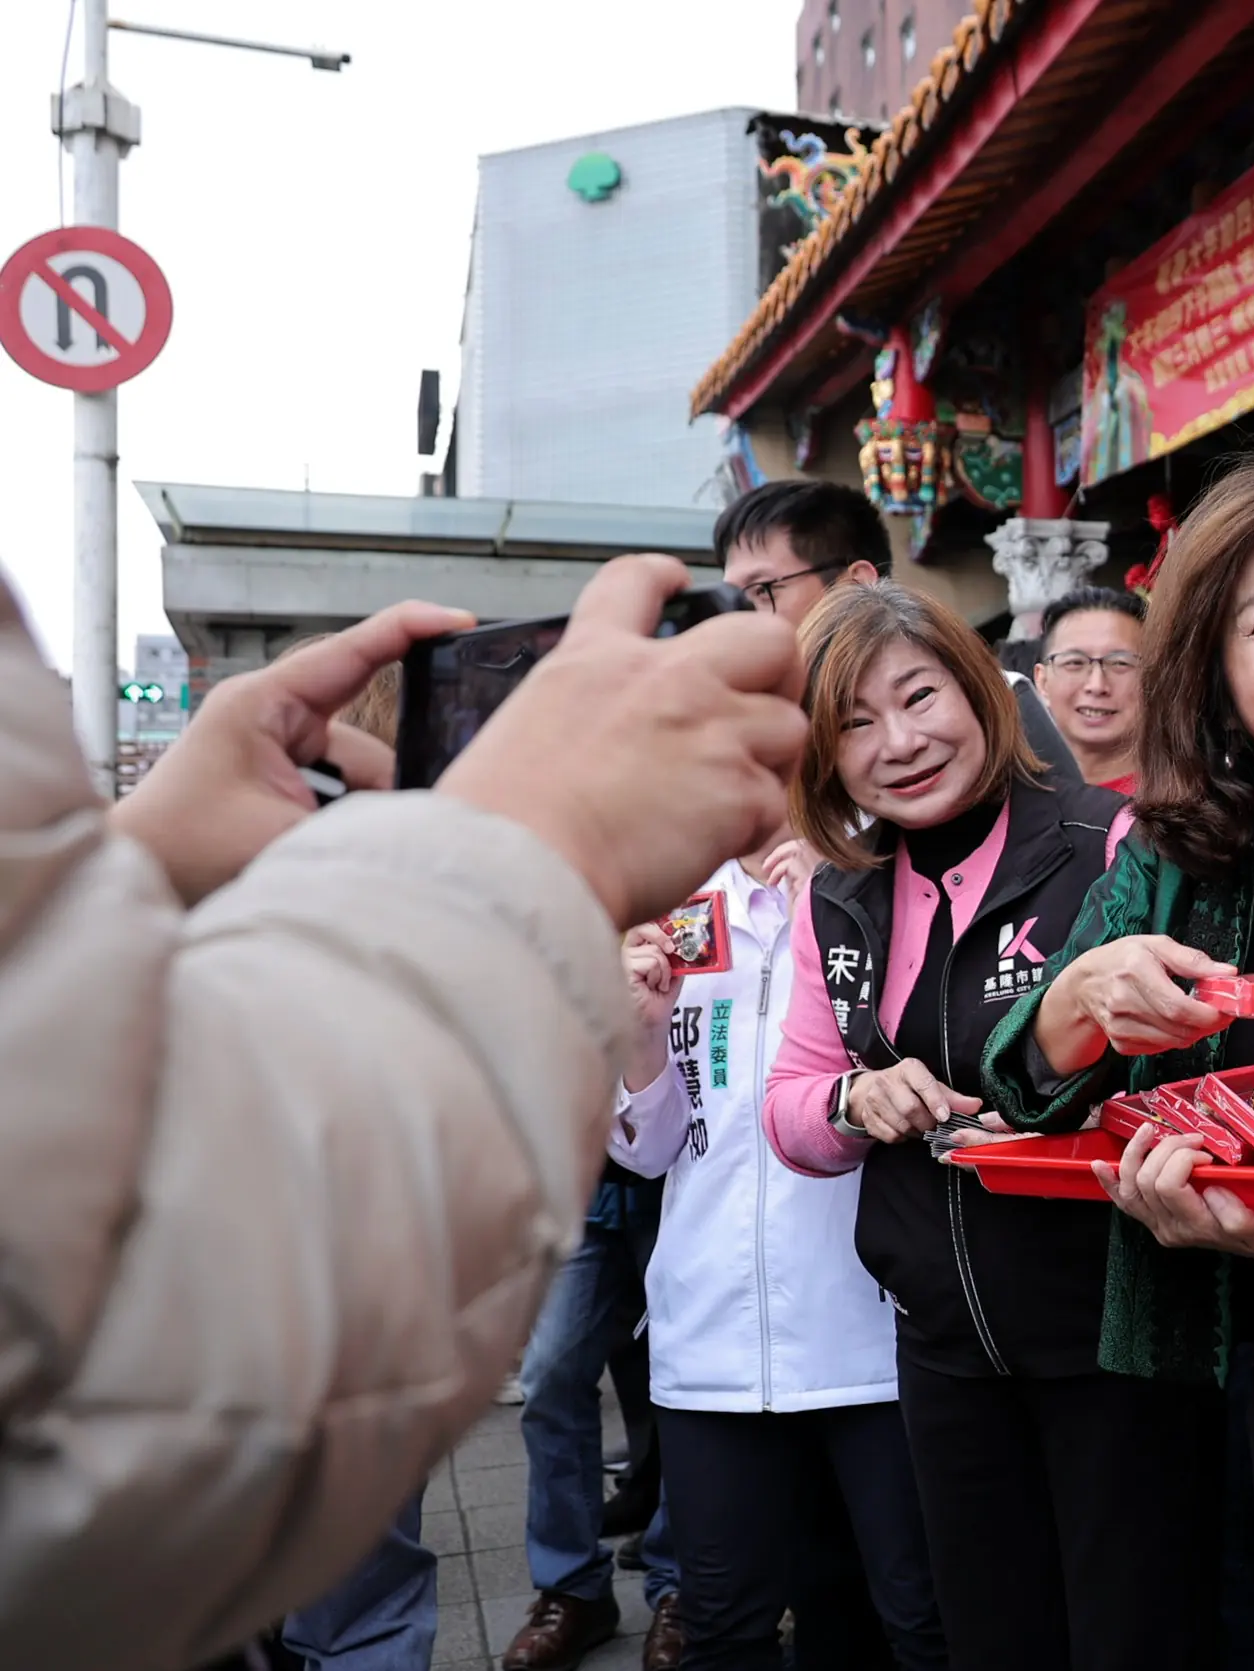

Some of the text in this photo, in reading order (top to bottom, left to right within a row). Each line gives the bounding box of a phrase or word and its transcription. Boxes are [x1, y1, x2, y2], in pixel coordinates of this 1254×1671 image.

[984, 985, 1031, 999] KEELUNG CITY
[711, 1003, 731, 1088] 立法委員
